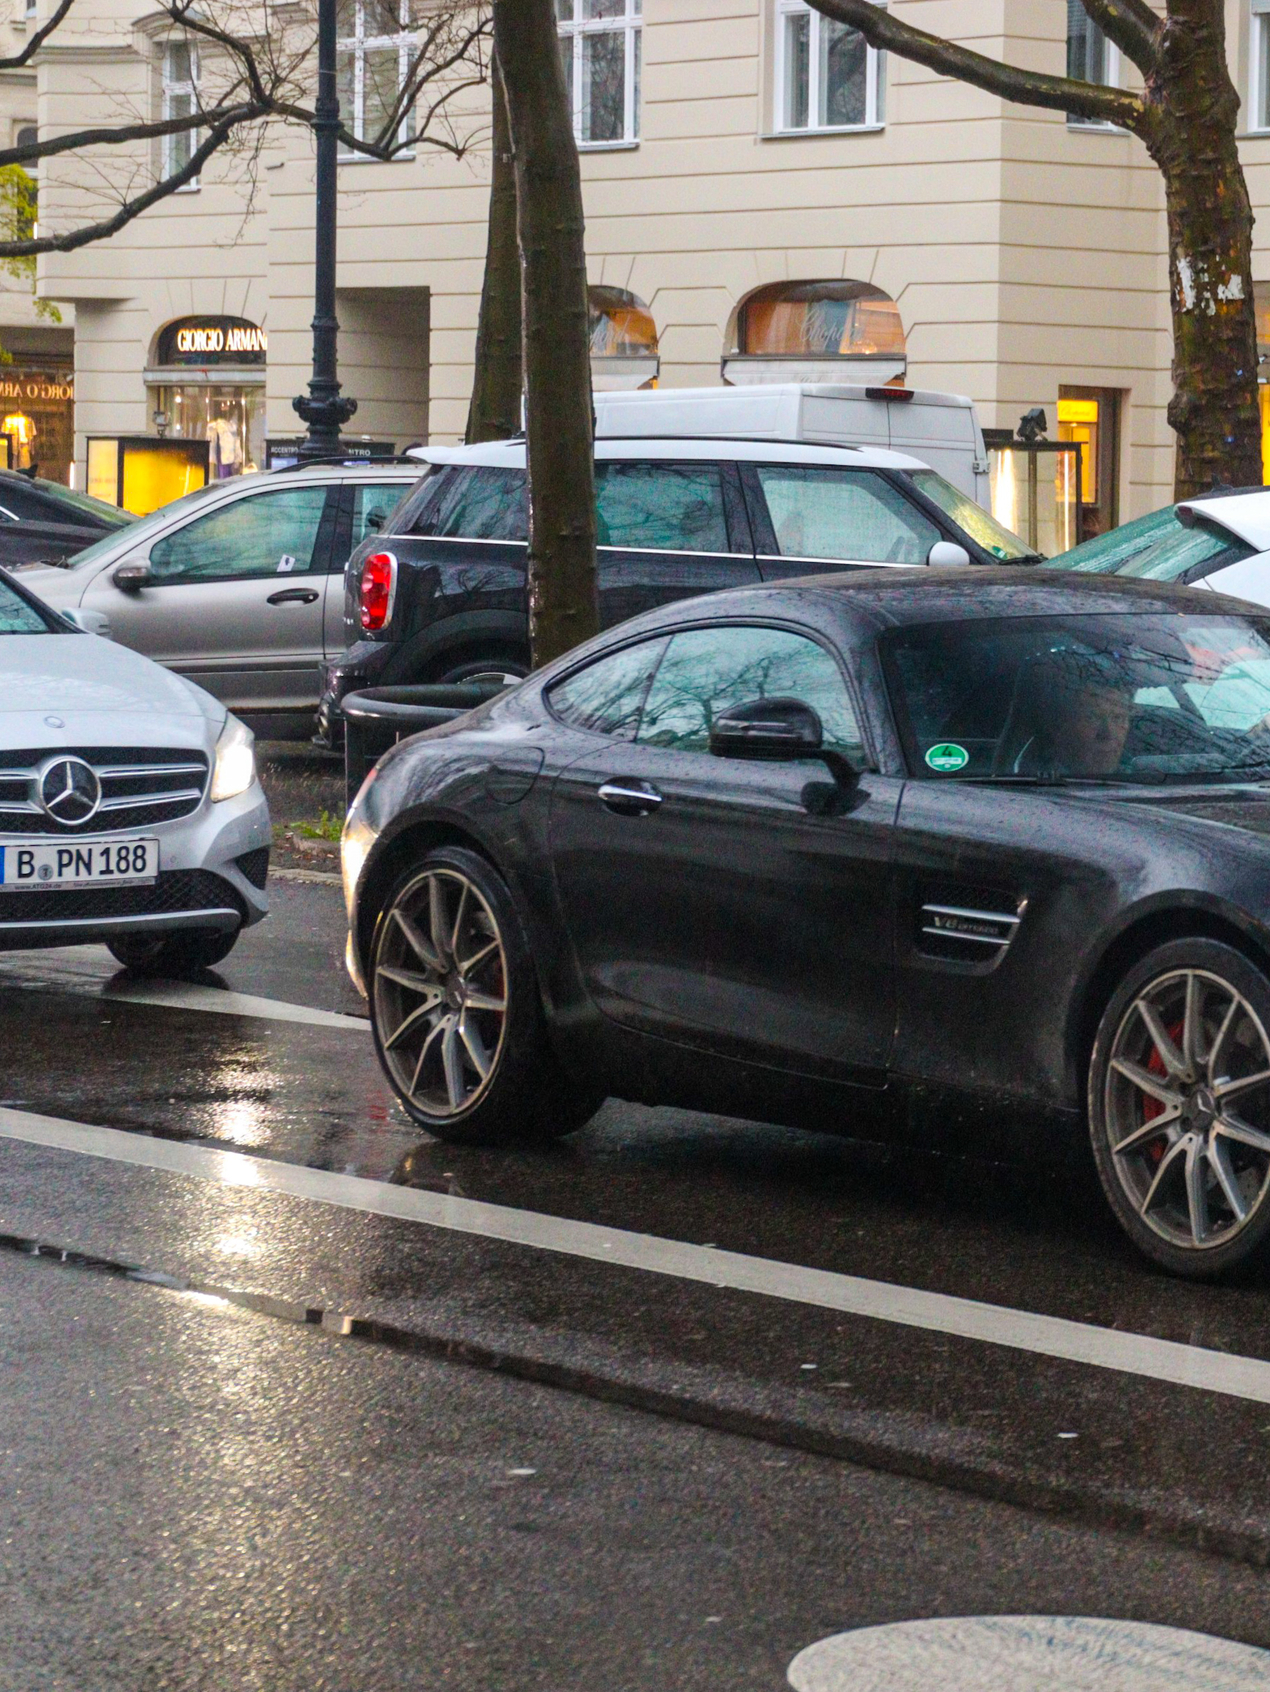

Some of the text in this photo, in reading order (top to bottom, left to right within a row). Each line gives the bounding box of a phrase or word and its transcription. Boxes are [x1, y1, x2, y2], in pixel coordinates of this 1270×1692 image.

[177, 327, 224, 352] GIORGIO
[941, 745, 953, 758] 4
[18, 844, 147, 879] B PN 188
